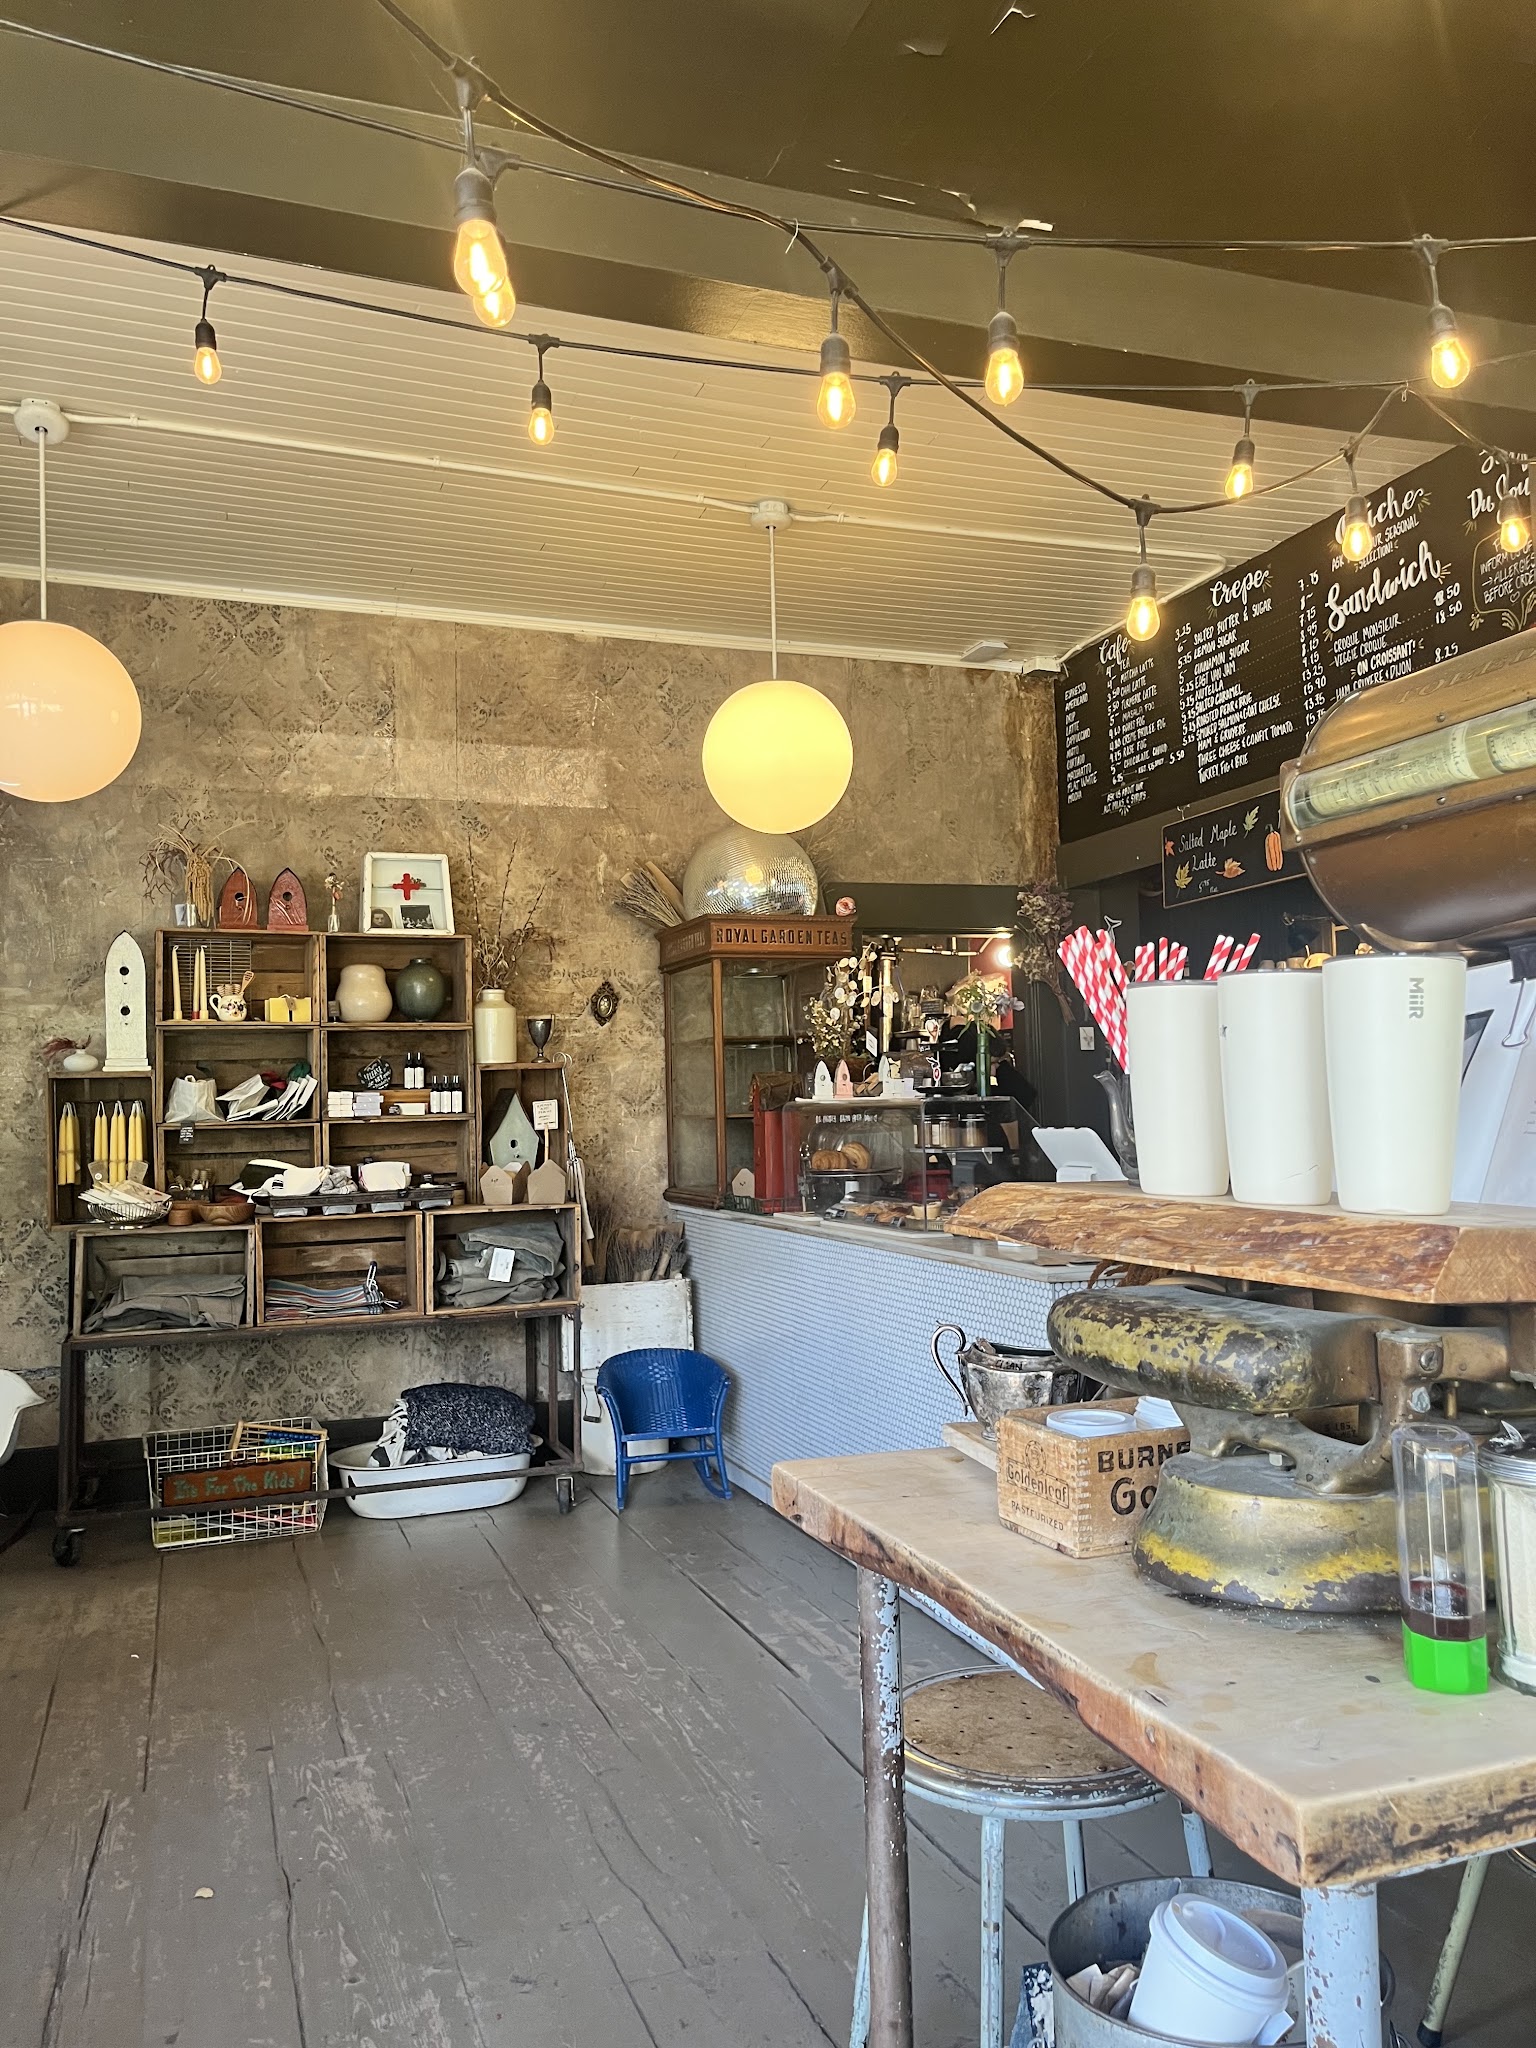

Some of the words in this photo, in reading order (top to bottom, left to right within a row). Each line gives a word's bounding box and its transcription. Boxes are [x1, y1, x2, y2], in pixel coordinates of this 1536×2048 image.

[1467, 487, 1495, 520] Du
[1384, 513, 1419, 542] SEASONAL
[1480, 551, 1509, 575] INFORM
[1210, 569, 1270, 607] Crepe
[1325, 540, 1441, 633] Sandwich
[1483, 577, 1514, 604] BEFORE
[1193, 626, 1215, 646] SALTED
[1216, 612, 1241, 636] BUTTER
[1251, 597, 1272, 618] SUGAR
[1333, 630, 1360, 654] CROQUE
[1362, 613, 1401, 641] MONSIEUR
[1334, 646, 1359, 668] VEGGIE
[1359, 634, 1388, 658] CROQUE
[1435, 600, 1463, 625] 18.50
[1193, 639, 1216, 660] LEMON
[1216, 628, 1238, 649] SUGAR
[1194, 651, 1226, 676] CINNAMON
[1228, 639, 1250, 661] SUGAR
[1356, 658, 1369, 677] ON
[1370, 638, 1416, 671] CROISSANT!
[1119, 656, 1131, 672] TEA
[1139, 657, 1155, 674] LATTE
[1194, 671, 1209, 690] EAST
[1210, 666, 1222, 683] VAN
[1222, 660, 1236, 678] JAM
[1389, 657, 1412, 680] DIJON
[1434, 641, 1459, 664] 8.25
[1131, 674, 1147, 693] LATTE
[1142, 684, 1158, 701] LATTE
[1195, 679, 1225, 702] NUTELLA
[1195, 696, 1215, 717] SALTED
[1214, 683, 1244, 706] CARAMEL
[1195, 721, 1218, 742] SMOKED
[1217, 711, 1240, 731] SALMON
[1243, 702, 1258, 720] GOAT
[1258, 692, 1282, 715] CHEESE
[1303, 675, 1327, 696] 15.90
[1196, 707, 1220, 730] ROASTED
[1220, 700, 1236, 719] PEAR
[1197, 736, 1213, 752] HAM
[1219, 721, 1247, 743] GRUYERE
[1197, 748, 1218, 769] THREE
[1218, 738, 1241, 759] CHEESE
[1245, 727, 1270, 748] CONFIT
[1269, 720, 1294, 738] TOMATO
[1234, 752, 1249, 769] BRIE
[1067, 779, 1080, 794] FLAT
[1080, 770, 1098, 788] WHITE
[1178, 826, 1204, 853] Salted
[1209, 819, 1238, 848] Maple
[1191, 851, 1217, 872] Latte
[716, 928, 758, 944] ROYAL
[761, 928, 814, 945] GARDEN
[817, 930, 848, 946] TEAS
[1408, 977, 1425, 1019] MiiR
[205, 1476, 228, 1497] For
[232, 1474, 258, 1493] The
[1007, 1462, 1067, 1504] Goldenleaf
[1110, 1476, 1158, 1516] Go
[1010, 1499, 1064, 1532] PASTEURIZED
